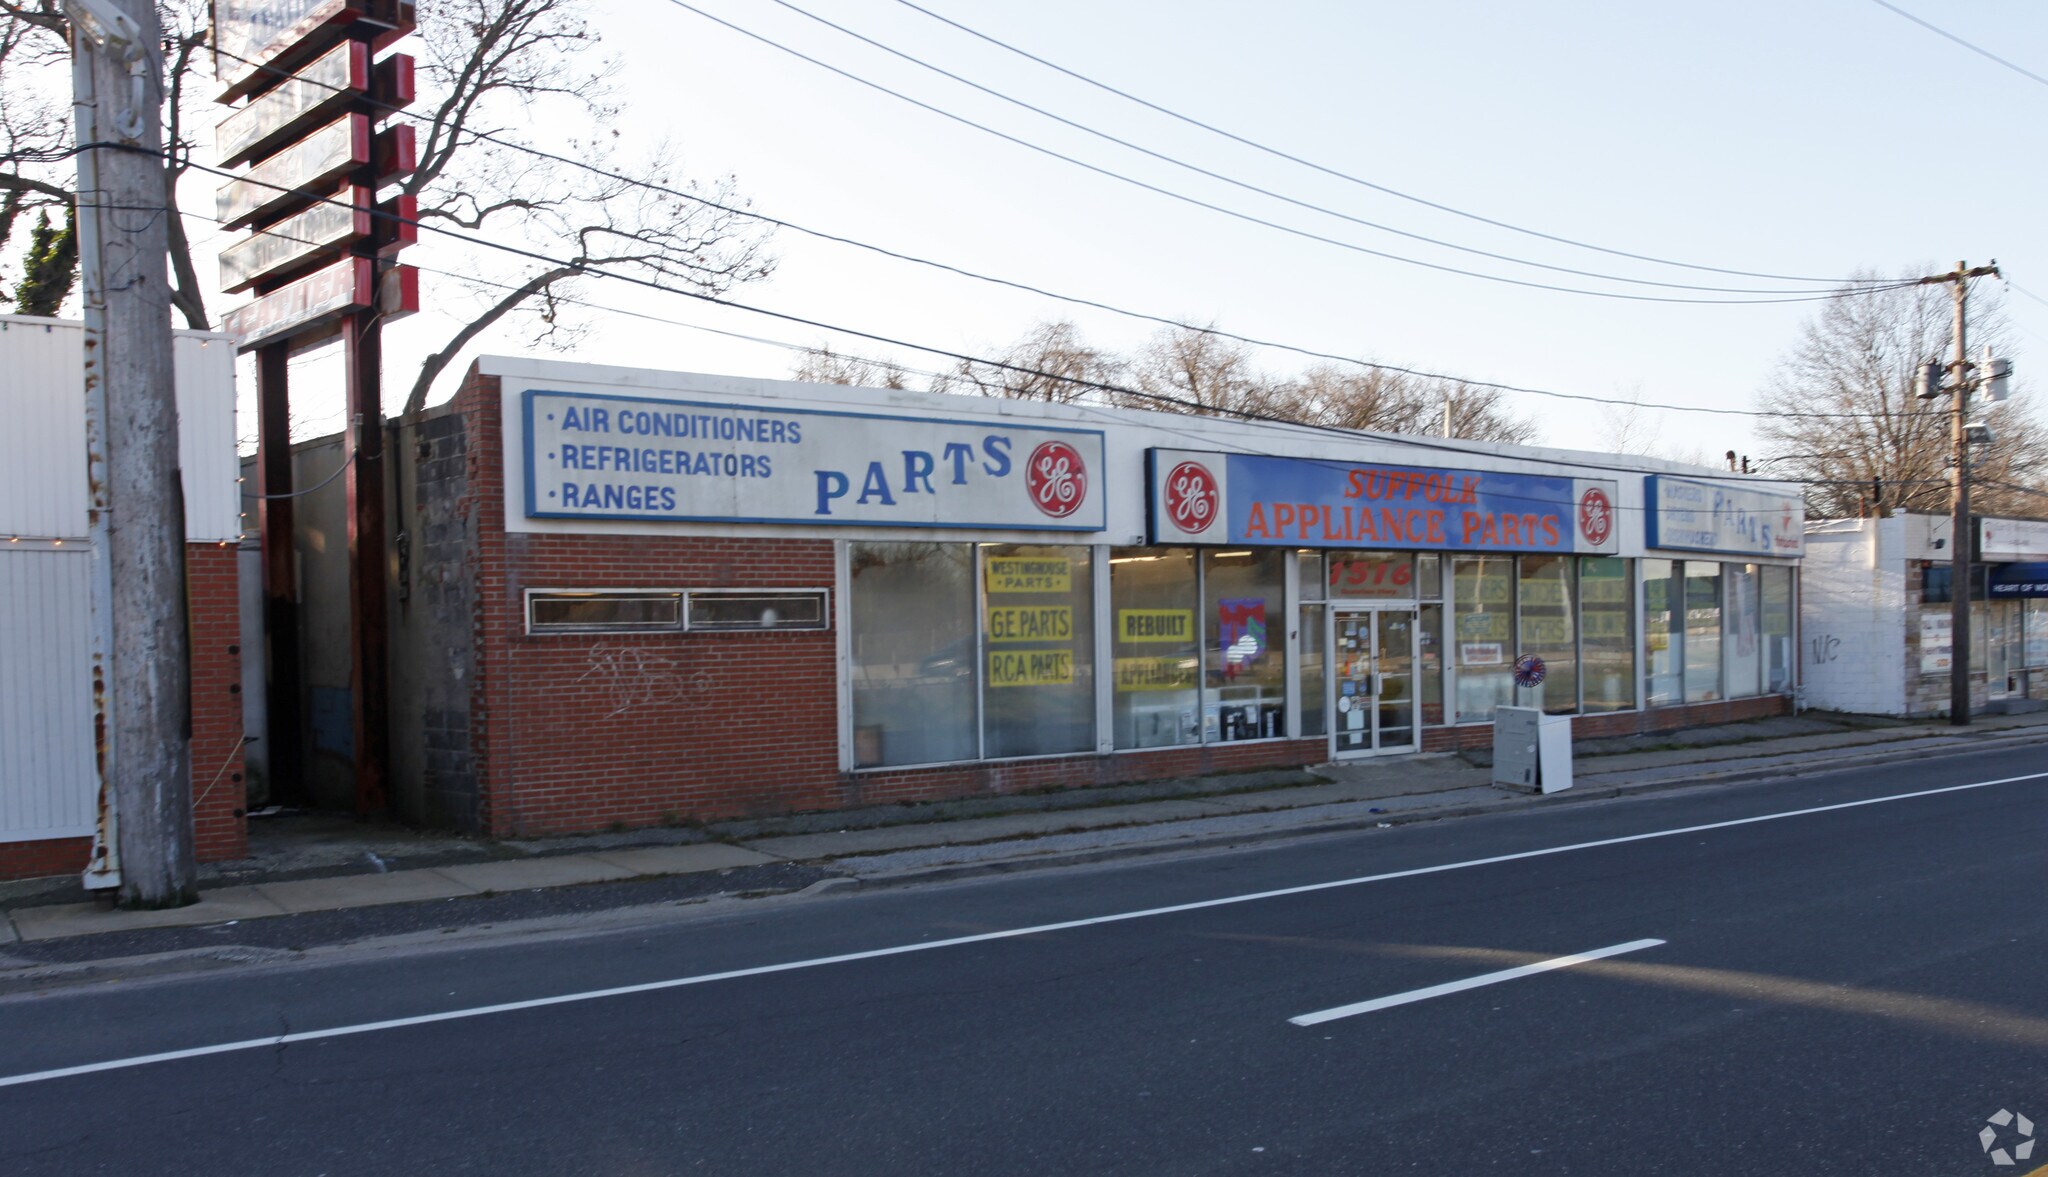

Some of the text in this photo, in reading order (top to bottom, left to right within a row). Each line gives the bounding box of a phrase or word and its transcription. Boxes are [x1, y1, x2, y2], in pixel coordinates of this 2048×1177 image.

[562, 406, 802, 444] AIR CONDITIONERS
[562, 444, 772, 478] REFRIGERATORS
[813, 434, 1013, 515] PARTS
[562, 482, 676, 511] RANGES
[1345, 467, 1482, 505] SUFFOLK
[1244, 502, 1560, 547] APPLIANCE PARTS
[1712, 490, 1771, 550] PARTS
[1005, 577, 1053, 588] PARTS
[991, 609, 1069, 638] GE PARTS
[1126, 615, 1186, 636] REBUILT
[993, 653, 1070, 682] RCA PARTS
